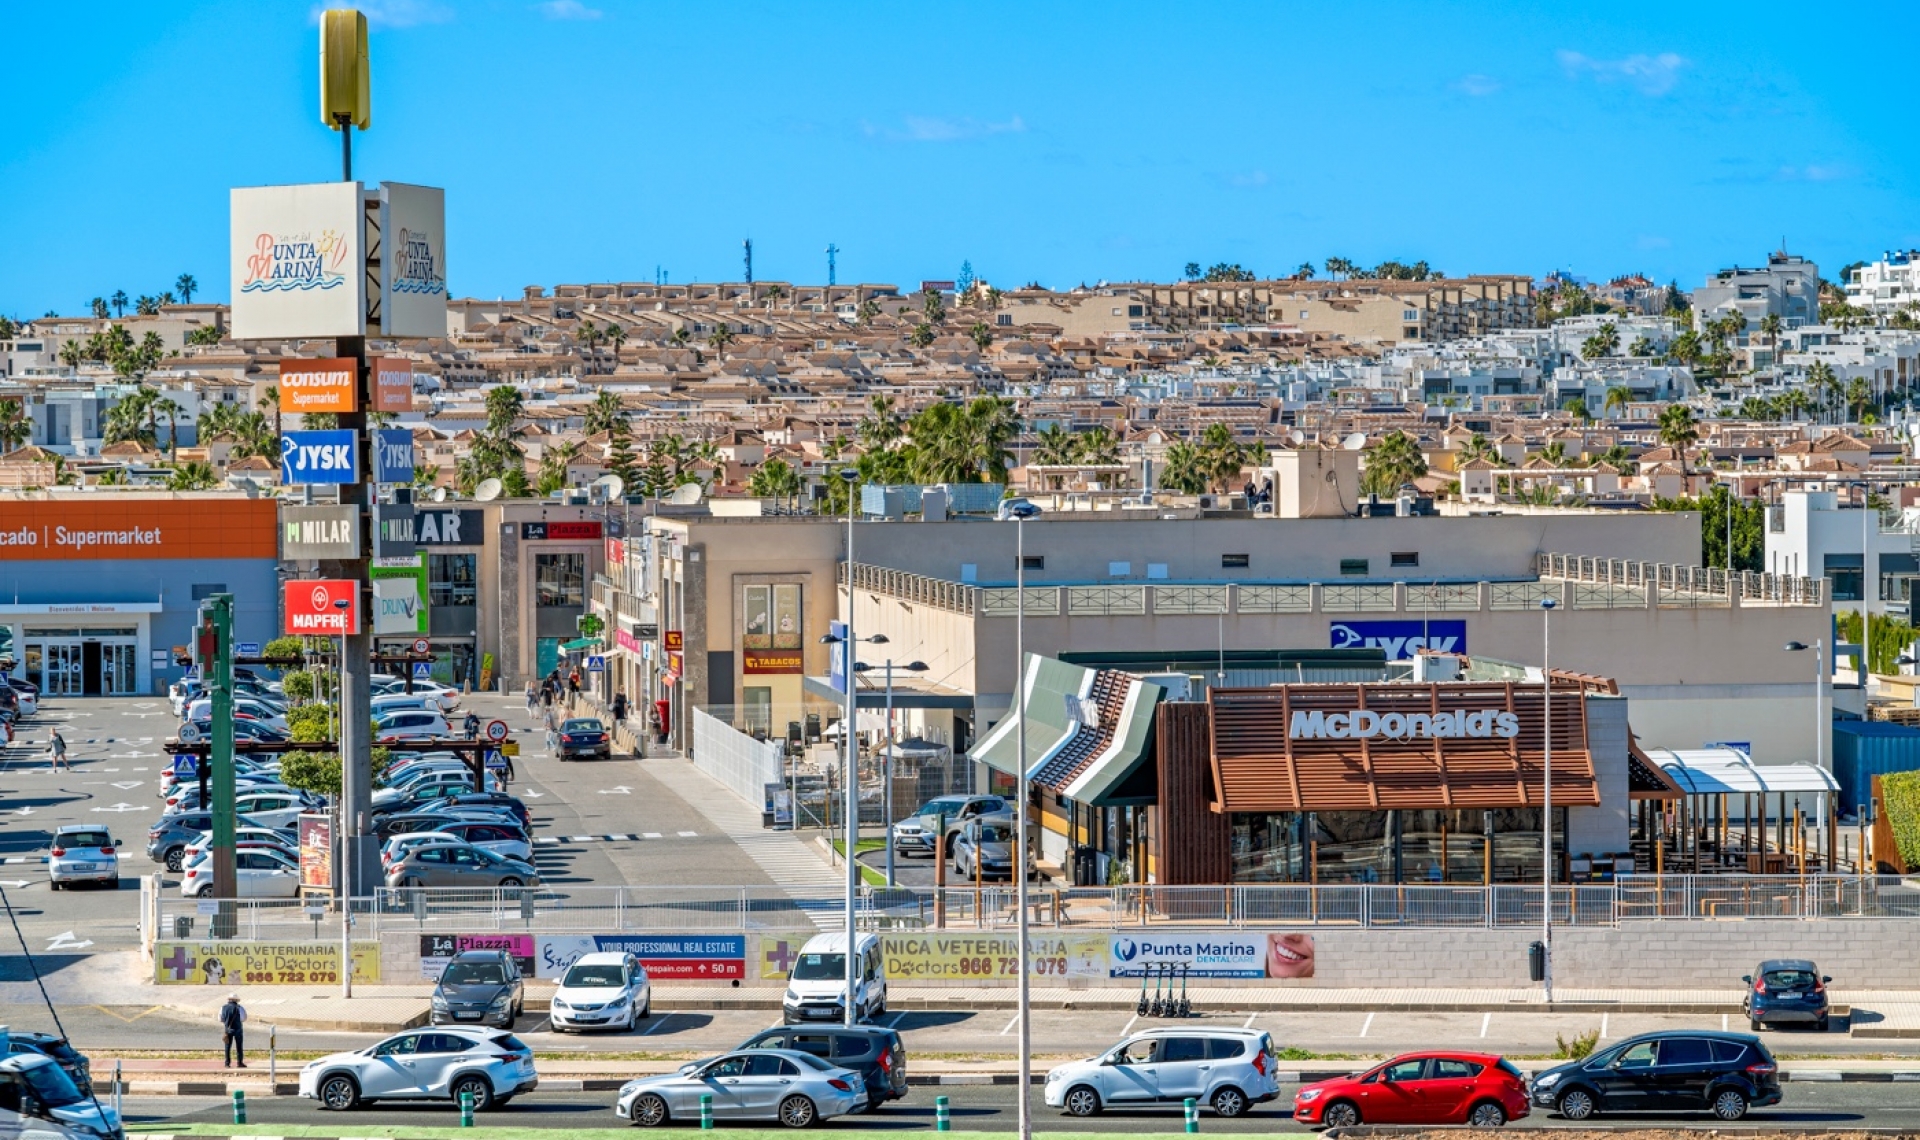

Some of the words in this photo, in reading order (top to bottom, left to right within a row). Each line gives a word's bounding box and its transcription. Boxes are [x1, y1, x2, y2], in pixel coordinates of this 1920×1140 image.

[256, 233, 317, 260] PUNTA
[243, 252, 324, 284] MARINA
[281, 371, 351, 387] consum
[379, 371, 410, 386] consum
[292, 391, 340, 407] Supermarket
[296, 445, 351, 470] JYSK
[386, 444, 412, 468] JYSK
[55, 525, 162, 550] Supermarket
[302, 520, 350, 544] MILAR
[388, 519, 414, 542] MILAR
[527, 525, 544, 535] La
[292, 614, 348, 628] MAPFRE
[758, 658, 802, 666] TABACOS
[491, 726, 504, 735] 20
[1289, 709, 1520, 739] McDonald's
[182, 729, 196, 738] 20
[201, 943, 250, 956] CLÍNICA
[254, 946, 336, 956] VETERINARIA
[432, 937, 453, 950] La
[459, 938, 512, 949] Plazza
[601, 942, 622, 953] YOUR
[624, 942, 682, 953] PROFESSIONAL
[684, 942, 704, 953] REAL
[706, 942, 736, 953] ESTATE
[885, 940, 931, 955] NICA
[1141, 942, 1193, 956] Punta
[1197, 942, 1256, 956] Marina
[245, 956, 269, 970] Pet
[712, 964, 724, 973] 50
[960, 957, 992, 974] 966
[998, 957, 1030, 974] 72
[1036, 957, 1067, 974] 079
[246, 972, 274, 982] 966
[278, 972, 306, 982] 722
[309, 972, 337, 982] 079
